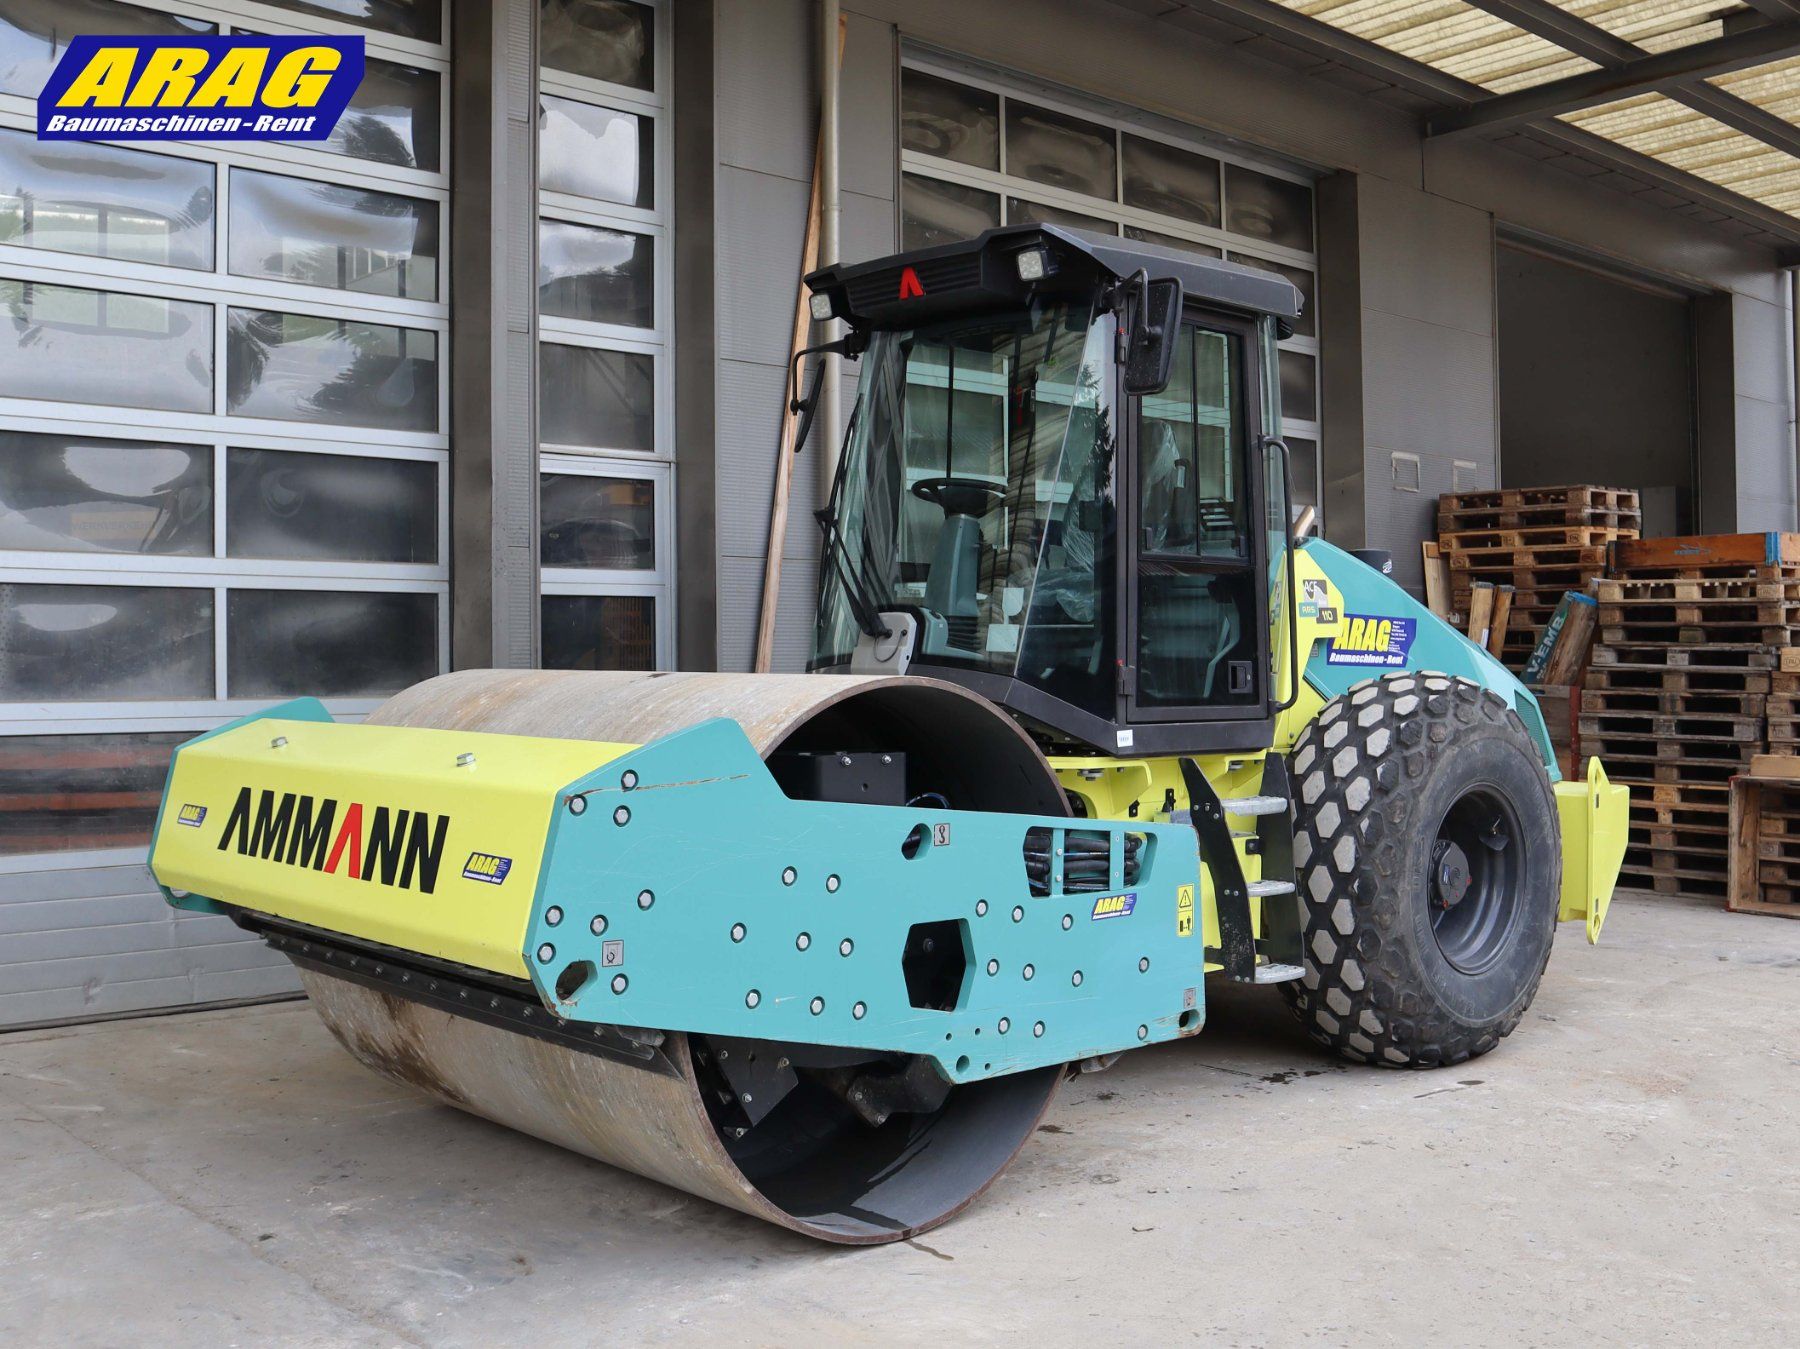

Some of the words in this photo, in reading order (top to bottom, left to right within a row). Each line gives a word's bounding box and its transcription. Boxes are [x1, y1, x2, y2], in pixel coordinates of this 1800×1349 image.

[1332, 617, 1391, 652] ARAG
[217, 786, 450, 894] AMMANN
[1094, 895, 1126, 915] ARAG
